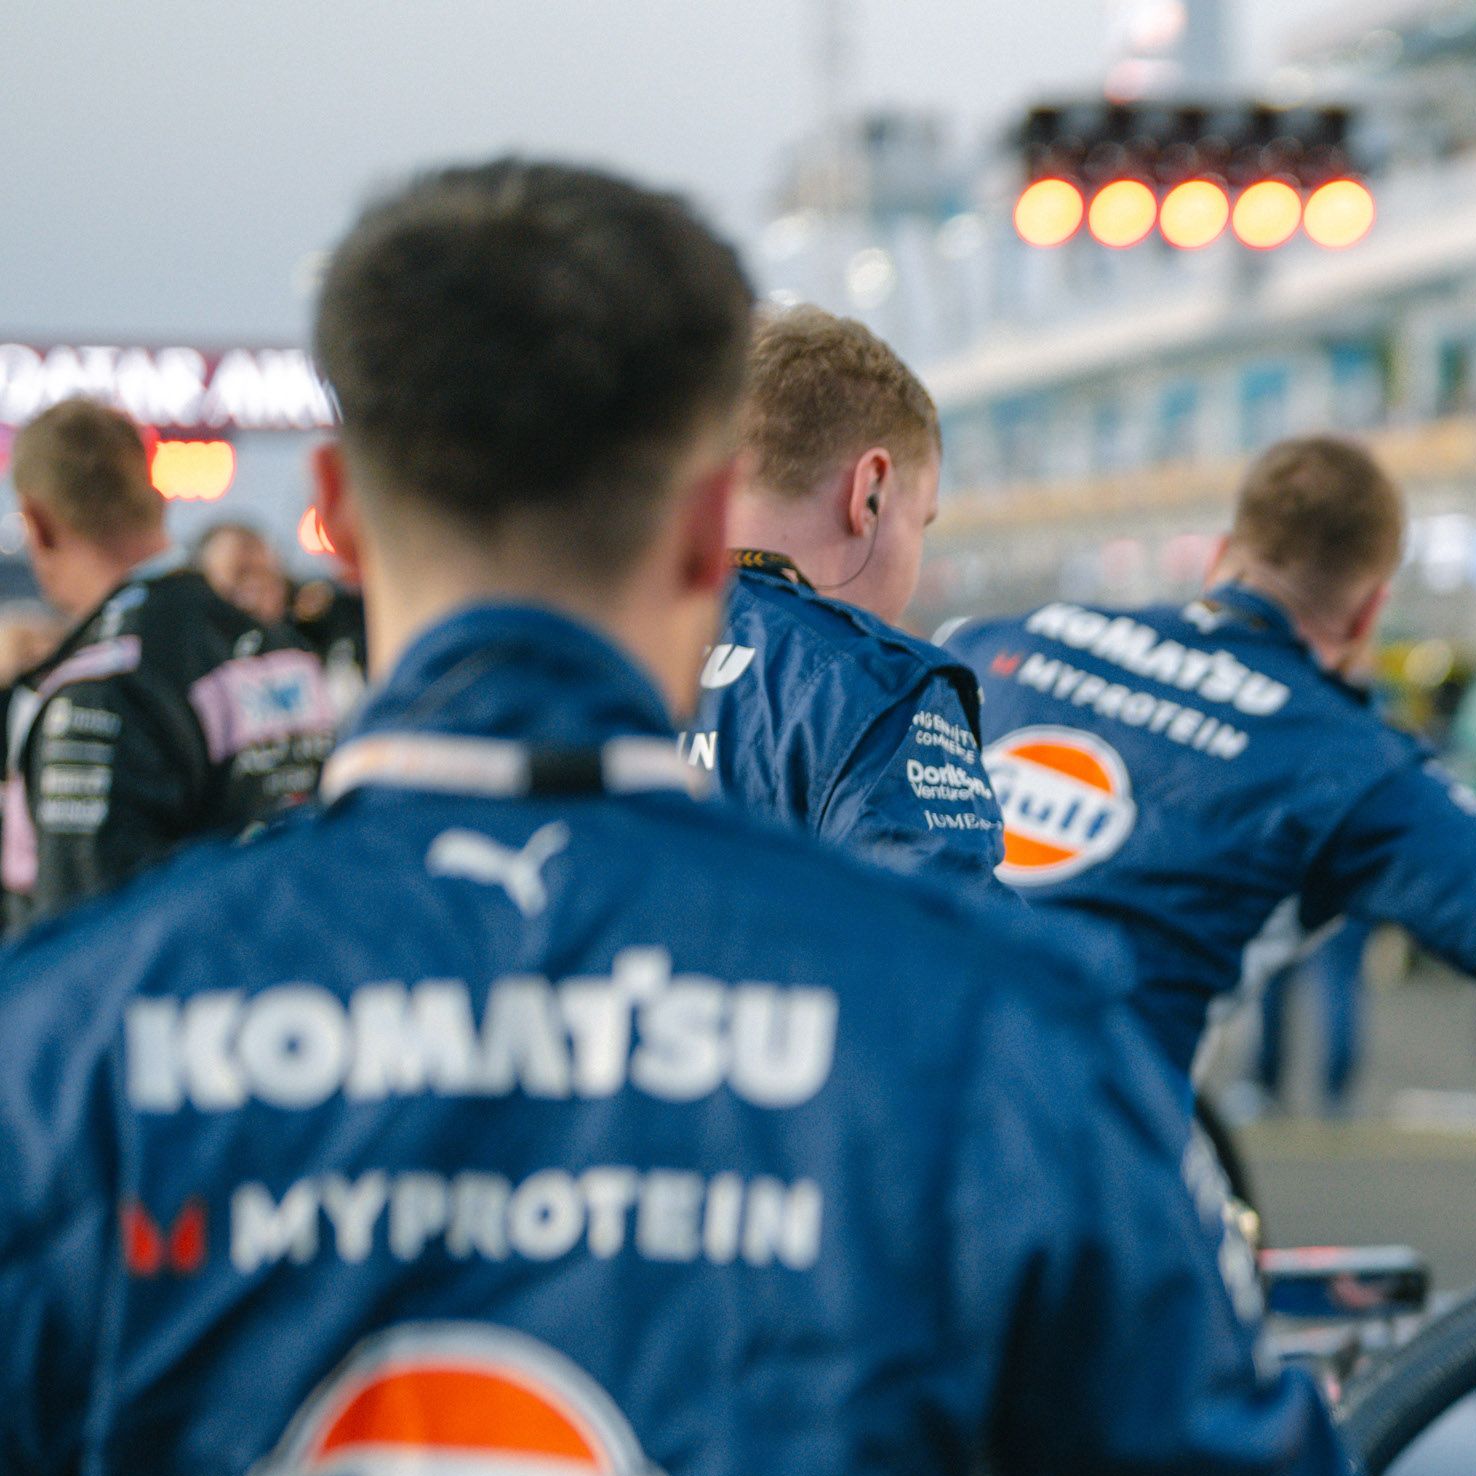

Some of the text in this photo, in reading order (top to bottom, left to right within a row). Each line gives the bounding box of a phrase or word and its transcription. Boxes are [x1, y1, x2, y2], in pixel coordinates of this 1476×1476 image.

[1017, 652, 1249, 761] MYPROTEIN
[1025, 602, 1291, 716] KOMATSU
[124, 946, 838, 1112] KOMATSU
[231, 1166, 824, 1274] MYPROTEIN
